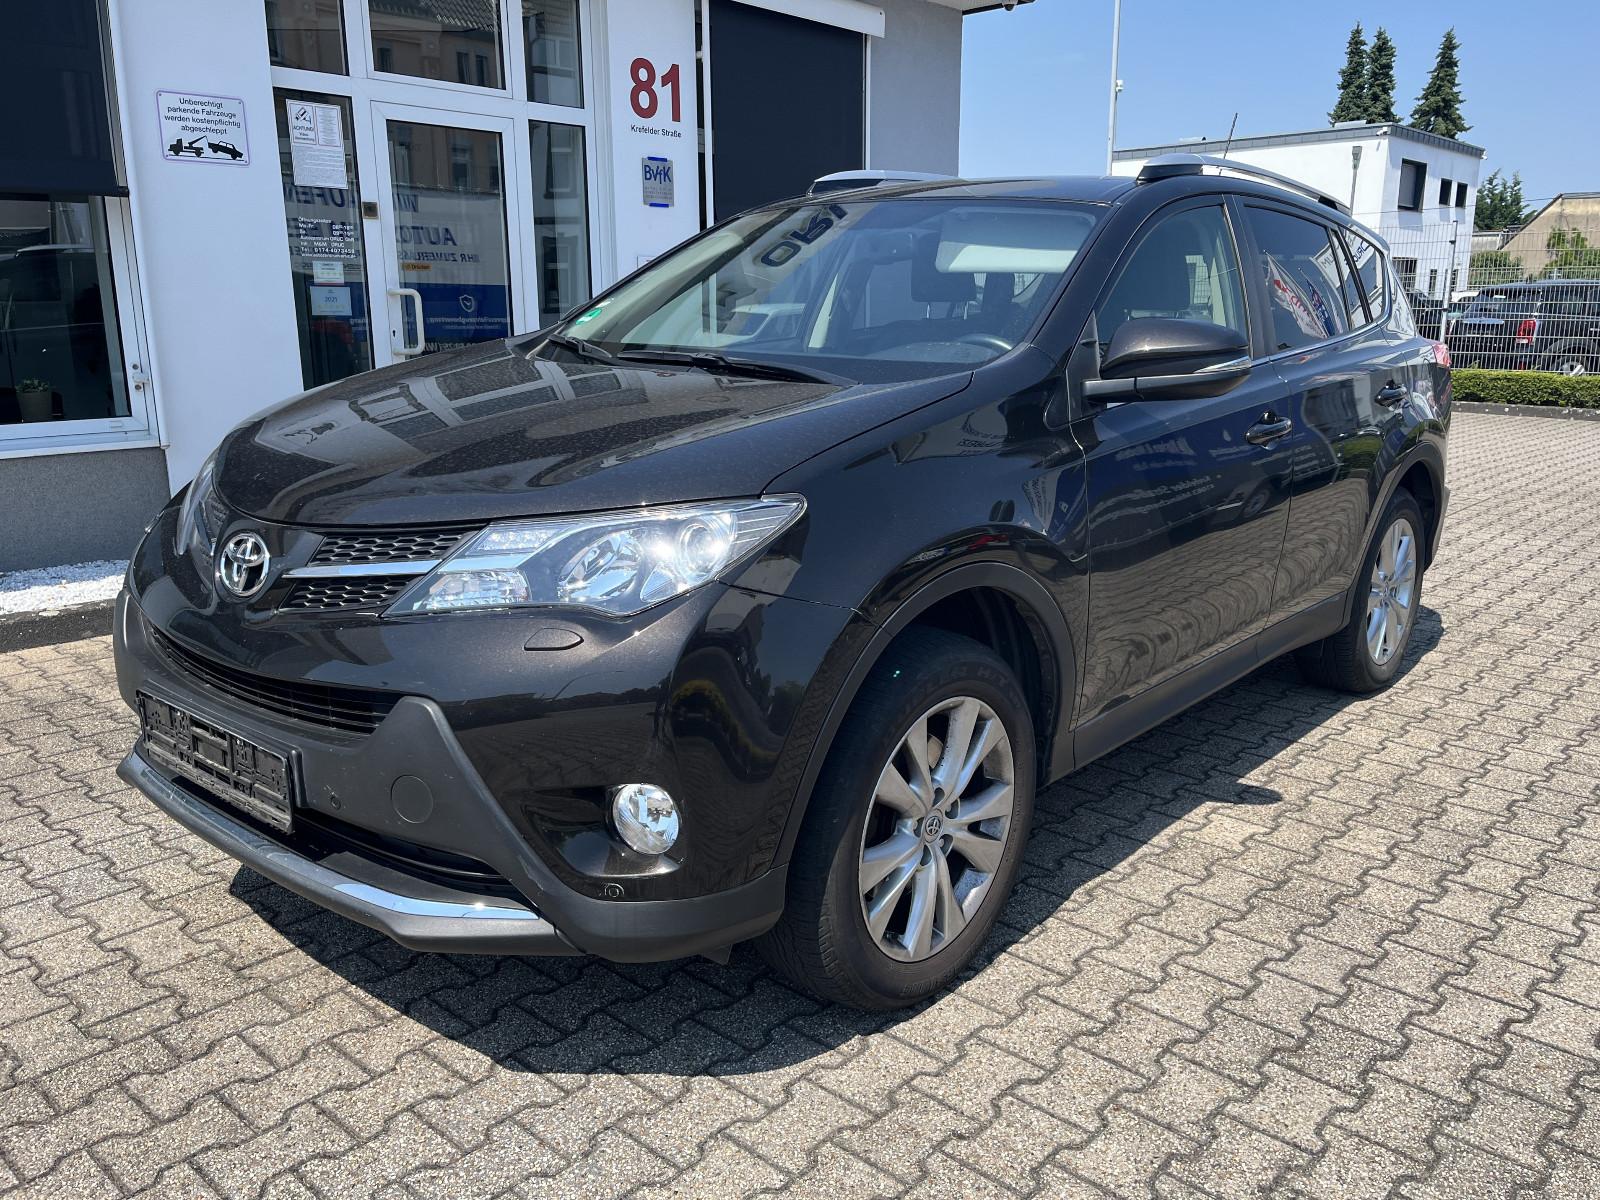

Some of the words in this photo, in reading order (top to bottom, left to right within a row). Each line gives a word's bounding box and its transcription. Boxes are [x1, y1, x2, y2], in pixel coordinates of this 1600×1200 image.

[630, 57, 681, 122] 81
[179, 98, 223, 109] Unberechtigt
[167, 106, 200, 115] parkende
[201, 108, 236, 119] Fahrzeuge
[191, 116, 241, 128] kostenpflichtig
[181, 125, 227, 135] abgeschleppt
[630, 124, 660, 135] Krefelder
[661, 128, 682, 138] Straße
